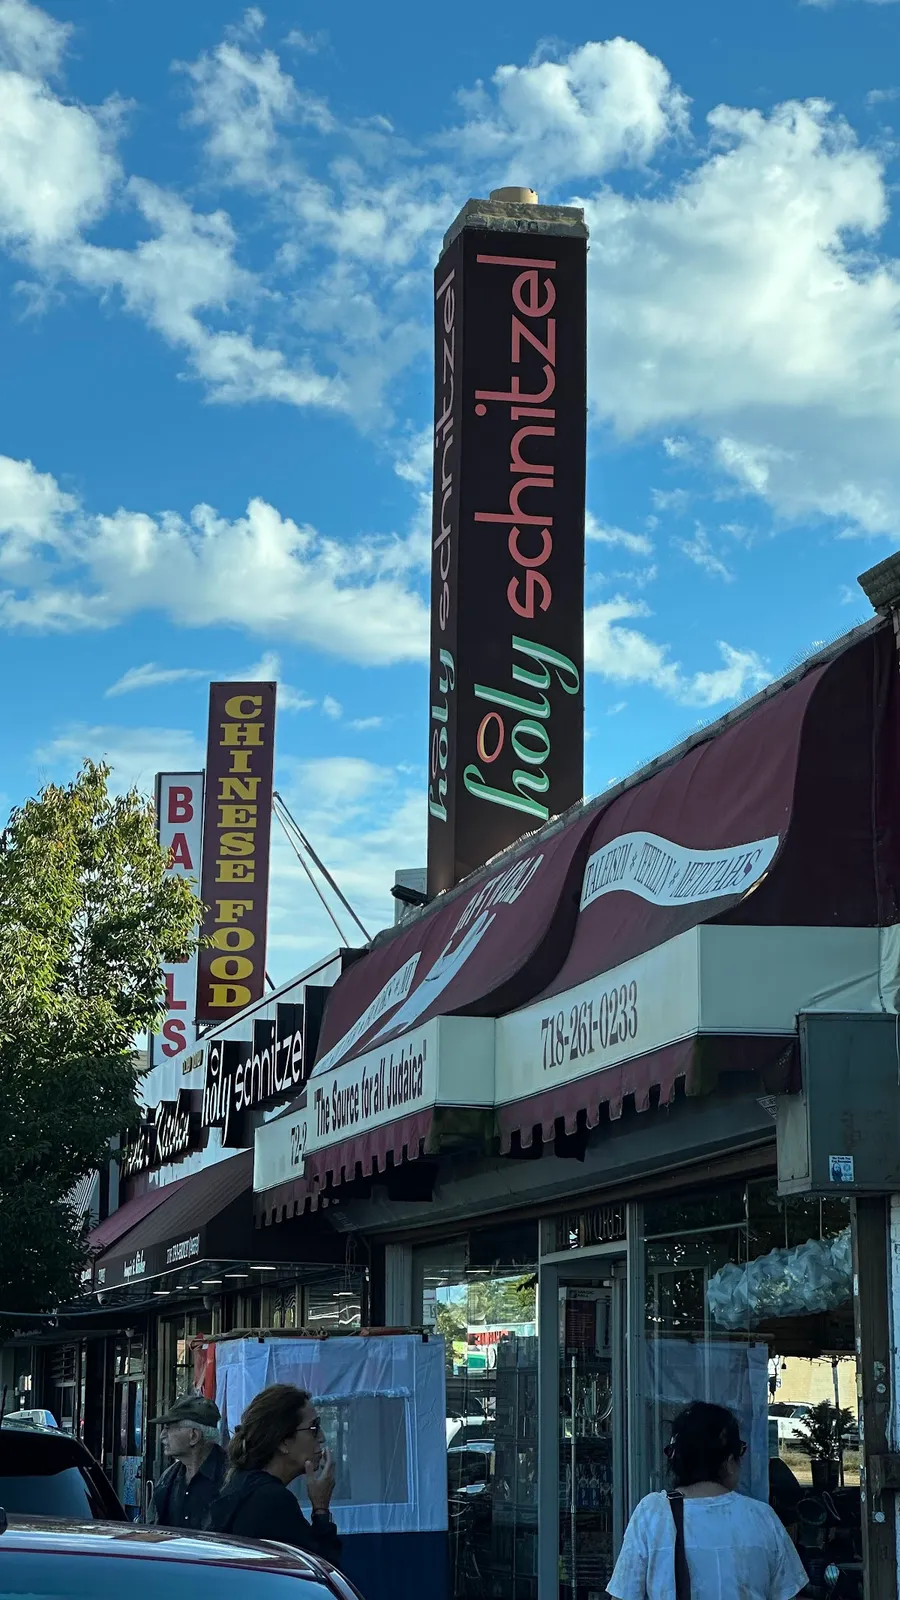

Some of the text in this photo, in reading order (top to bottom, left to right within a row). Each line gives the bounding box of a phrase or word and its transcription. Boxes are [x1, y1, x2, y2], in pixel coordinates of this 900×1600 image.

[430, 269, 455, 822] holy schnitzel
[463, 254, 580, 820] holy schnitzel
[161, 786, 194, 1058] BALS
[208, 695, 265, 1007] CHINESE FOOD
[201, 1039, 232, 1148] holy
[235, 985, 306, 1112] schnitzel
[331, 1079, 359, 1132] Source
[361, 1065, 373, 1119] for
[373, 1057, 386, 1115] all
[541, 980, 638, 1071] 718-261-0233
